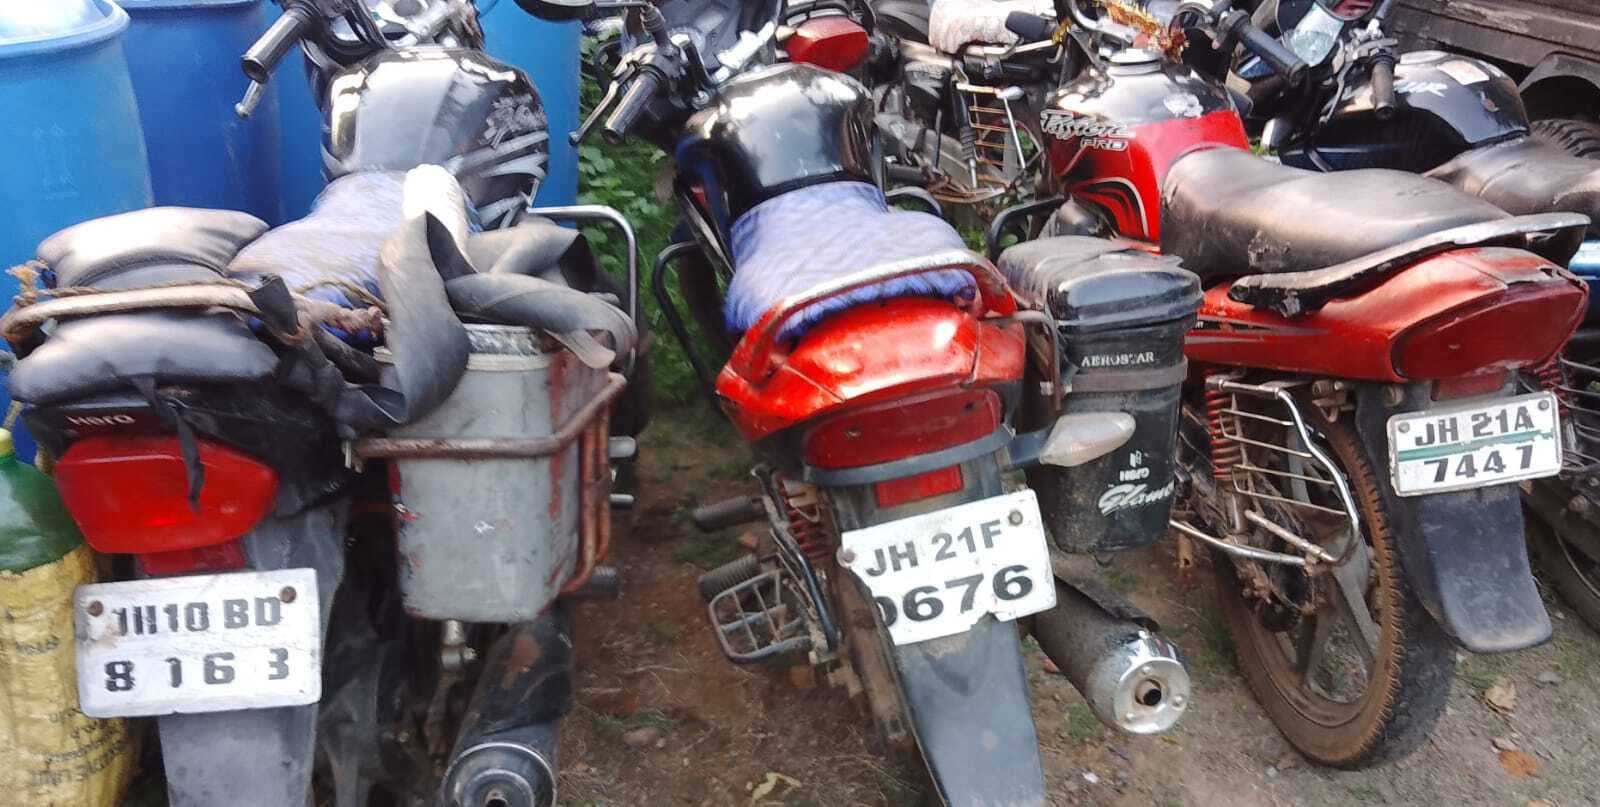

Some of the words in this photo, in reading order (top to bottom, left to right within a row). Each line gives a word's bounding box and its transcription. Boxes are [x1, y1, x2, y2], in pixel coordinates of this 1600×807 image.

[1080, 137, 1129, 152] PRO
[1415, 417, 1459, 446] JH
[1471, 406, 1534, 438] 21A
[1424, 445, 1534, 483] 7447
[865, 541, 918, 577] JH
[931, 519, 1002, 562] 21F
[223, 596, 282, 629] BD
